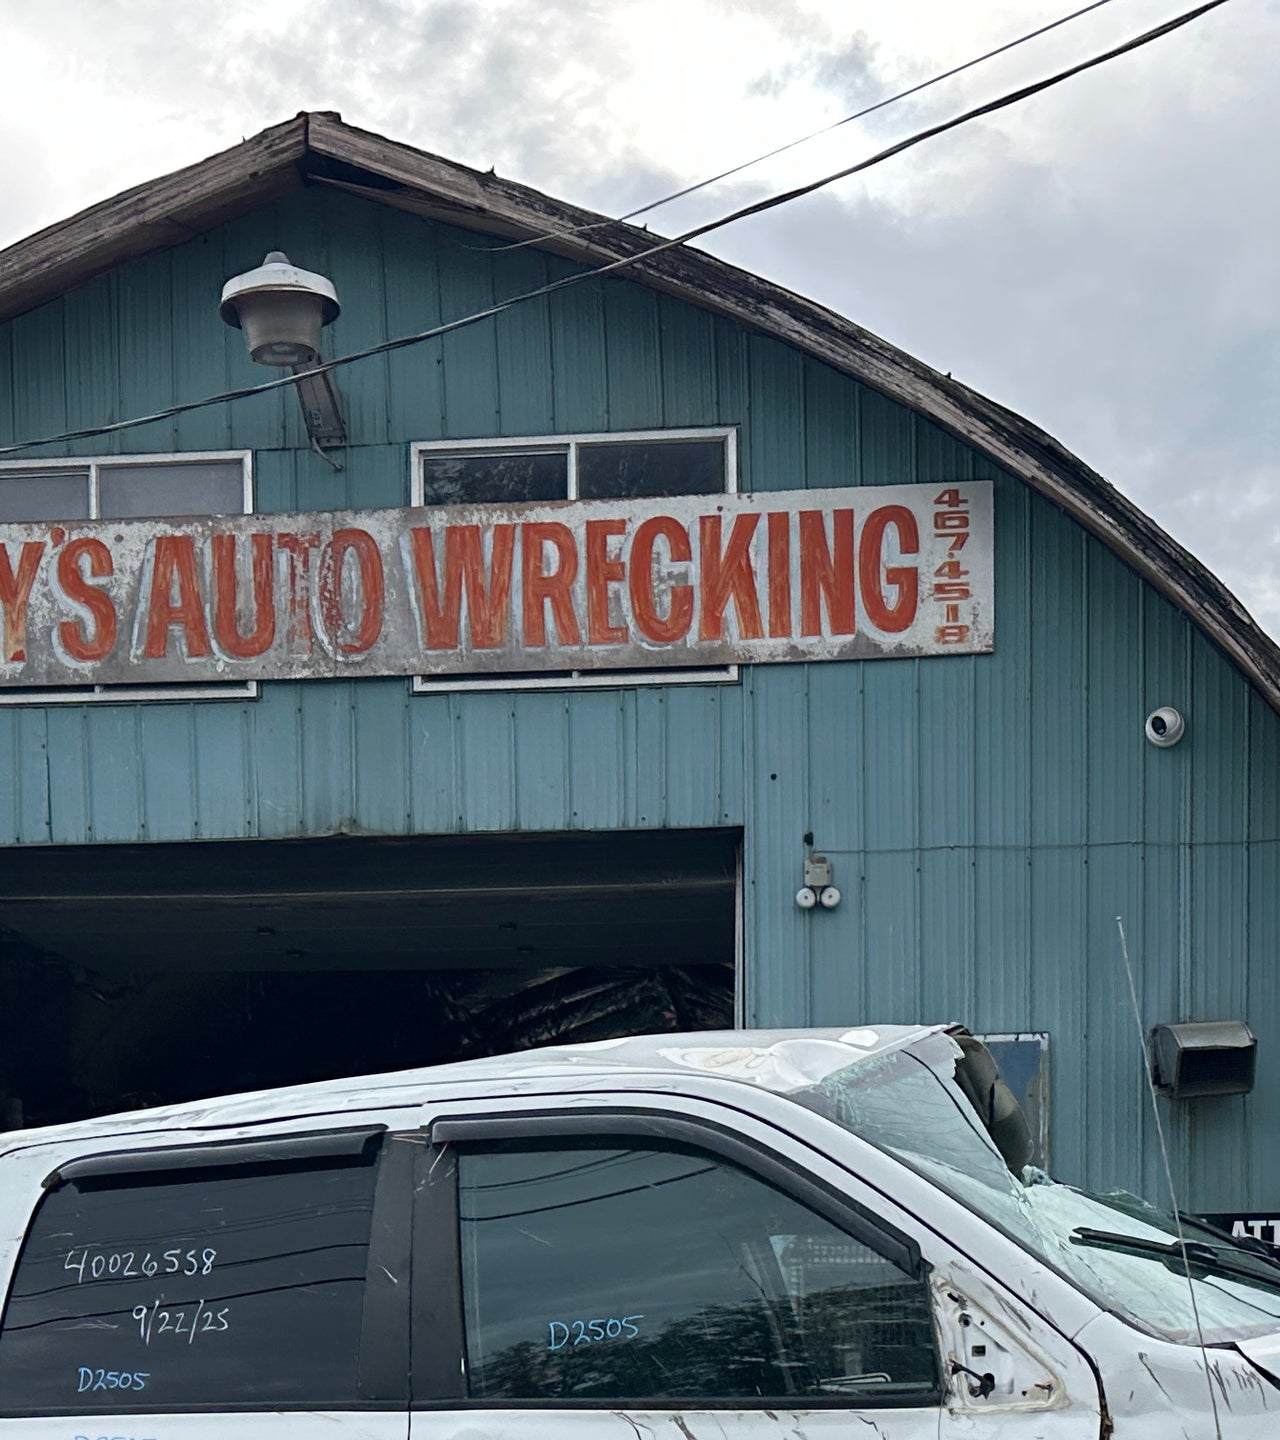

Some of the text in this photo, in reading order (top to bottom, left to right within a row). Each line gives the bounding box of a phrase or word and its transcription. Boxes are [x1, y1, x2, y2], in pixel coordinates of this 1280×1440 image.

[142, 527, 385, 661] AUTO
[411, 504, 919, 650] WRECKING
[64, 1248, 217, 1284] 40026558
[132, 1299, 230, 1346] 9/22/25
[547, 1314, 646, 1352] D2505
[77, 1366, 151, 1393] D2505
